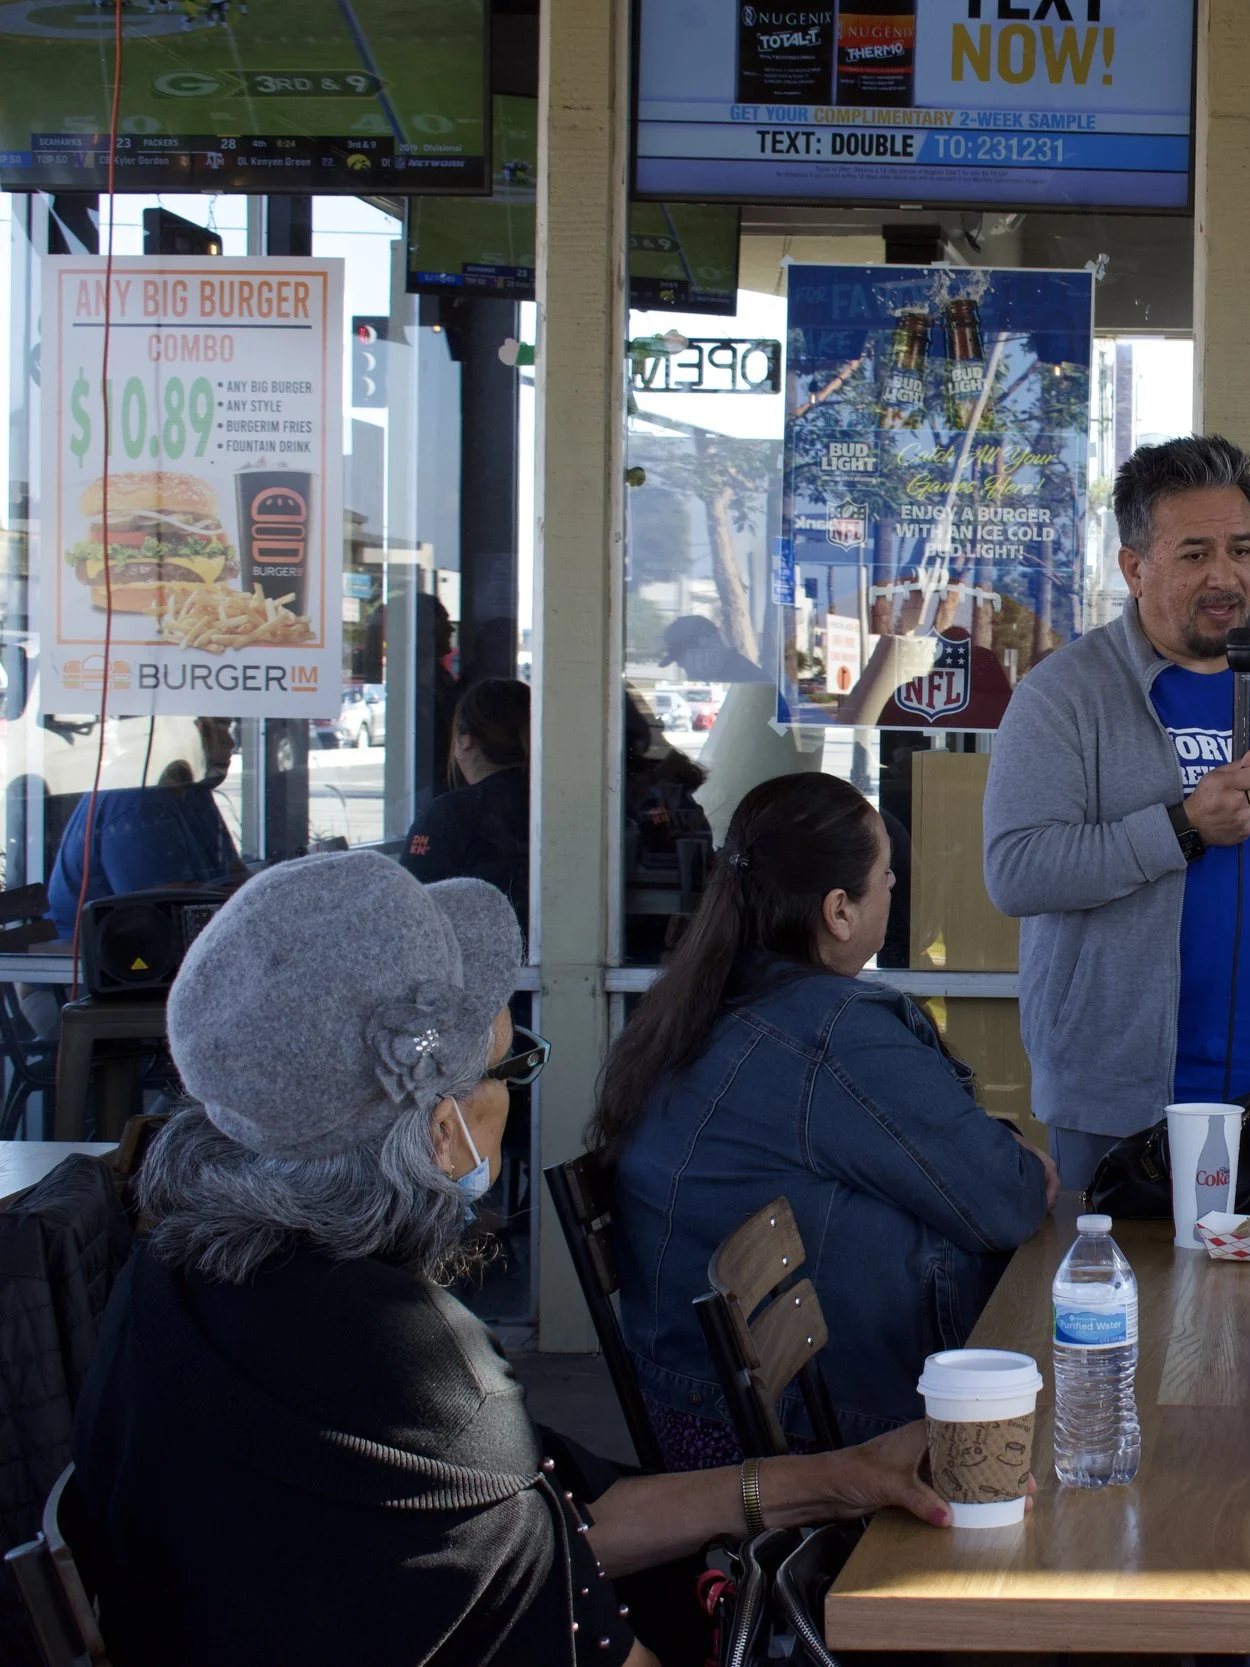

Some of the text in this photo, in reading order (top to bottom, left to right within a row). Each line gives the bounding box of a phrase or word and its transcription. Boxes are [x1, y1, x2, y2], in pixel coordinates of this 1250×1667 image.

[760, 12, 832, 26] NUGENIX
[760, 29, 819, 50] TOTAL-T
[847, 26, 913, 38] NUGENIX
[848, 43, 904, 61] THERMO
[951, 23, 1115, 86] NOW!
[254, 75, 368, 94] 3RD & 9
[730, 104, 1096, 130] GET YOUR COMPLIMENTARY 2-WEEK SAMPLE
[39, 137, 132, 148] SEAHAWKS 23
[143, 138, 237, 149] PACKERS 28
[756, 129, 1064, 162] TEXT: DOUBLE TO: 231231
[75, 279, 310, 319] ANY BIG BURGER
[147, 334, 235, 362] COMBO
[951, 366, 983, 382] BUD
[226, 381, 313, 394] ANY BIG BURGER
[892, 375, 923, 391] BUD
[226, 400, 282, 412] ANY STYLE
[69, 365, 215, 469] $10.89
[226, 421, 313, 433] BURGERIM FRIES
[226, 440, 311, 453] FOUNTAIN DRINK
[829, 442, 869, 456] BUD
[821, 457, 877, 472] LIGHT
[1000, 446, 1056, 474] Your
[901, 504, 1051, 523] ENJOY A BURGER
[895, 524, 1056, 542] WITH AN ICE COLD
[925, 543, 1024, 560] BUD LIGHT!
[904, 670, 961, 710] NFL
[1196, 1169, 1230, 1187] Coke
[1060, 1319, 1094, 1331] Purified
[1096, 1319, 1122, 1331] Water
